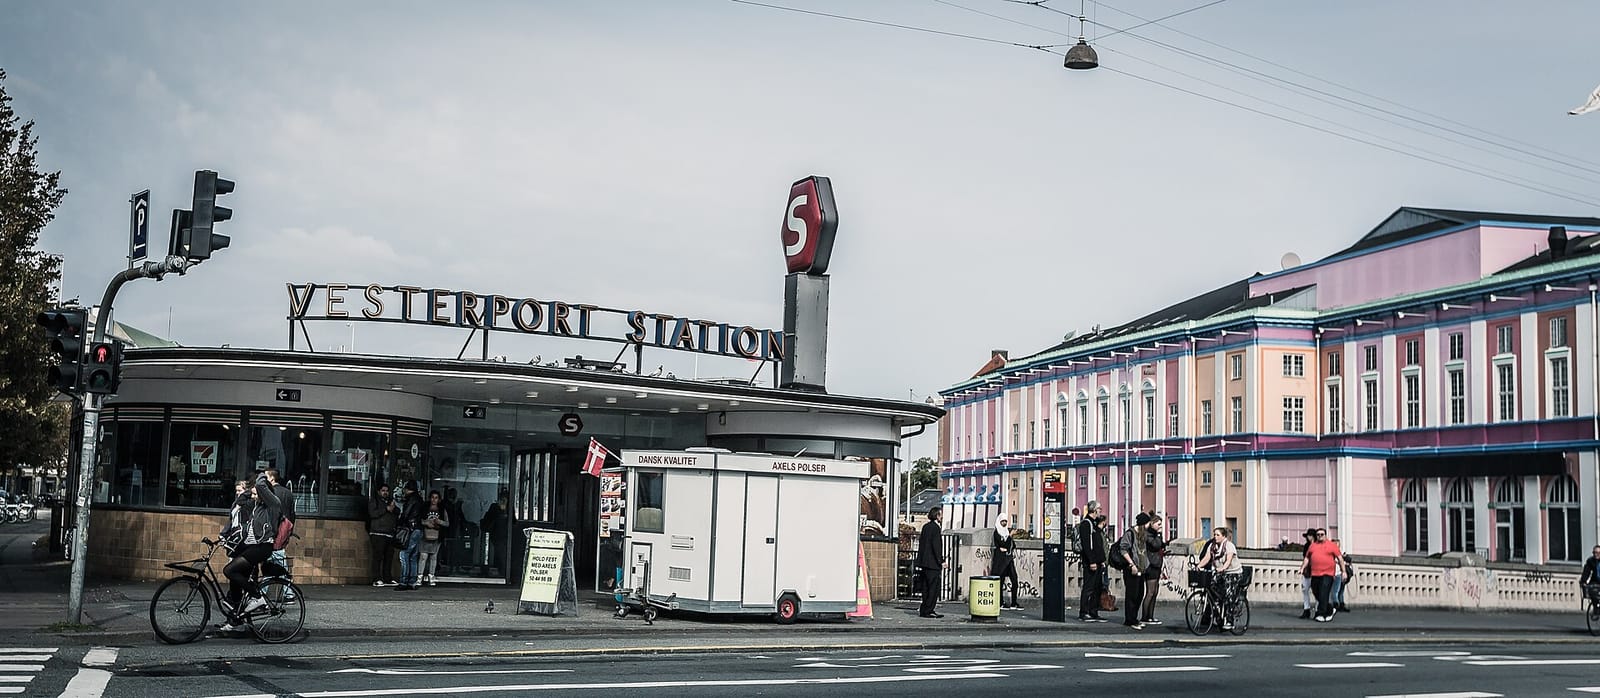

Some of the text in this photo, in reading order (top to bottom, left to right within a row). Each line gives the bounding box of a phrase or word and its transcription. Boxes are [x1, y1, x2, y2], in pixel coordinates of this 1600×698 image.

[137, 208, 145, 236] P
[786, 194, 808, 257] S
[286, 282, 786, 360] VESTERPORT STATION
[564, 418, 579, 433] S
[638, 456, 697, 466] DANSK KVALITET
[772, 461, 826, 473] AXELS PØLSER
[977, 590, 994, 598] REN
